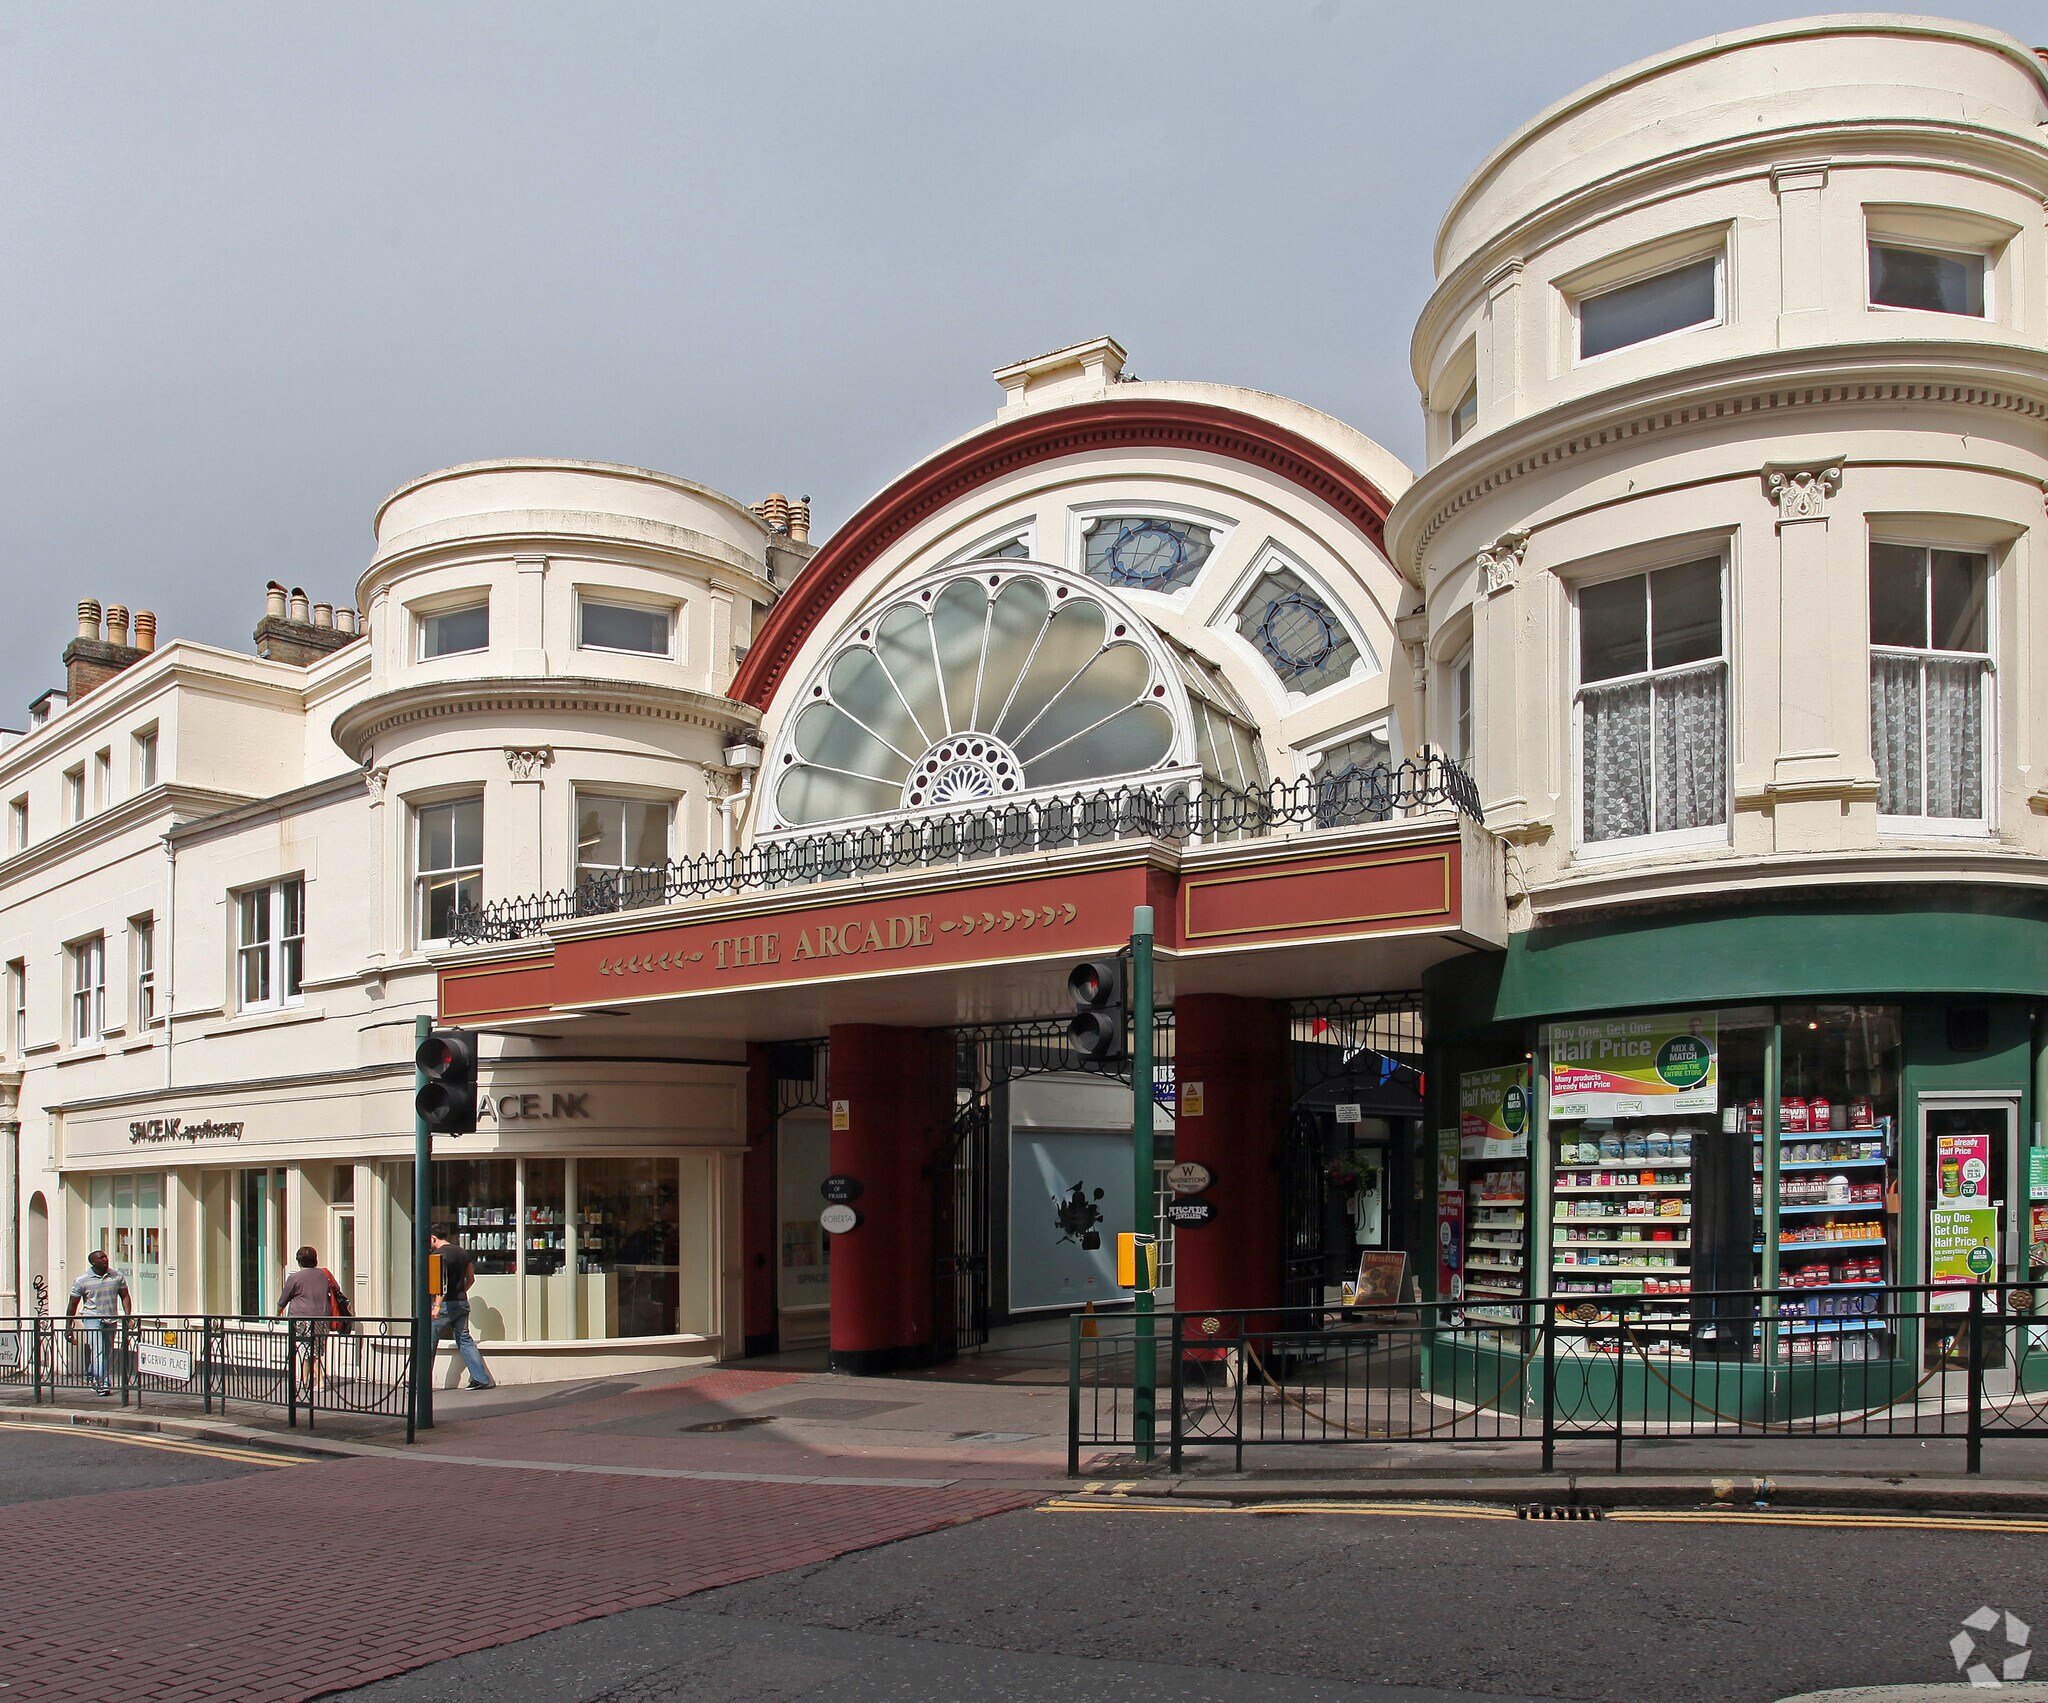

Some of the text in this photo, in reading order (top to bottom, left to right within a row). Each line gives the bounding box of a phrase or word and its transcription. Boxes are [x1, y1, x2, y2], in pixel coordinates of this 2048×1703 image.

[711, 911, 935, 969] THE ARCADE
[1554, 1021, 1652, 1041] Buy One, Get One
[1553, 1037, 1652, 1062] Half Price
[1671, 1043, 1696, 1053] MIX &
[1669, 1051, 1698, 1062] MATCH
[1666, 1063, 1688, 1072] ACROSS
[1554, 1073, 1602, 1083] Many products
[1663, 1069, 1703, 1078] ENTIRE STORE
[1554, 1080, 1611, 1091] already Half Price
[1462, 1086, 1501, 1107] Half Price
[477, 1092, 590, 1123] ACE.NK
[1953, 1138, 1978, 1147] already
[1939, 1147, 1972, 1155] Half Price
[1182, 1166, 1194, 1176] W
[1167, 1205, 1209, 1218] ARCADE
[823, 1214, 854, 1223] ROBERTA
[1934, 1212, 1973, 1225] Buy One,
[1934, 1224, 1969, 1236] Get One
[1934, 1236, 1978, 1248] Half Price
[1, 1336, 9, 1347] All
[147, 1353, 188, 1371] GERVIS PLACE
